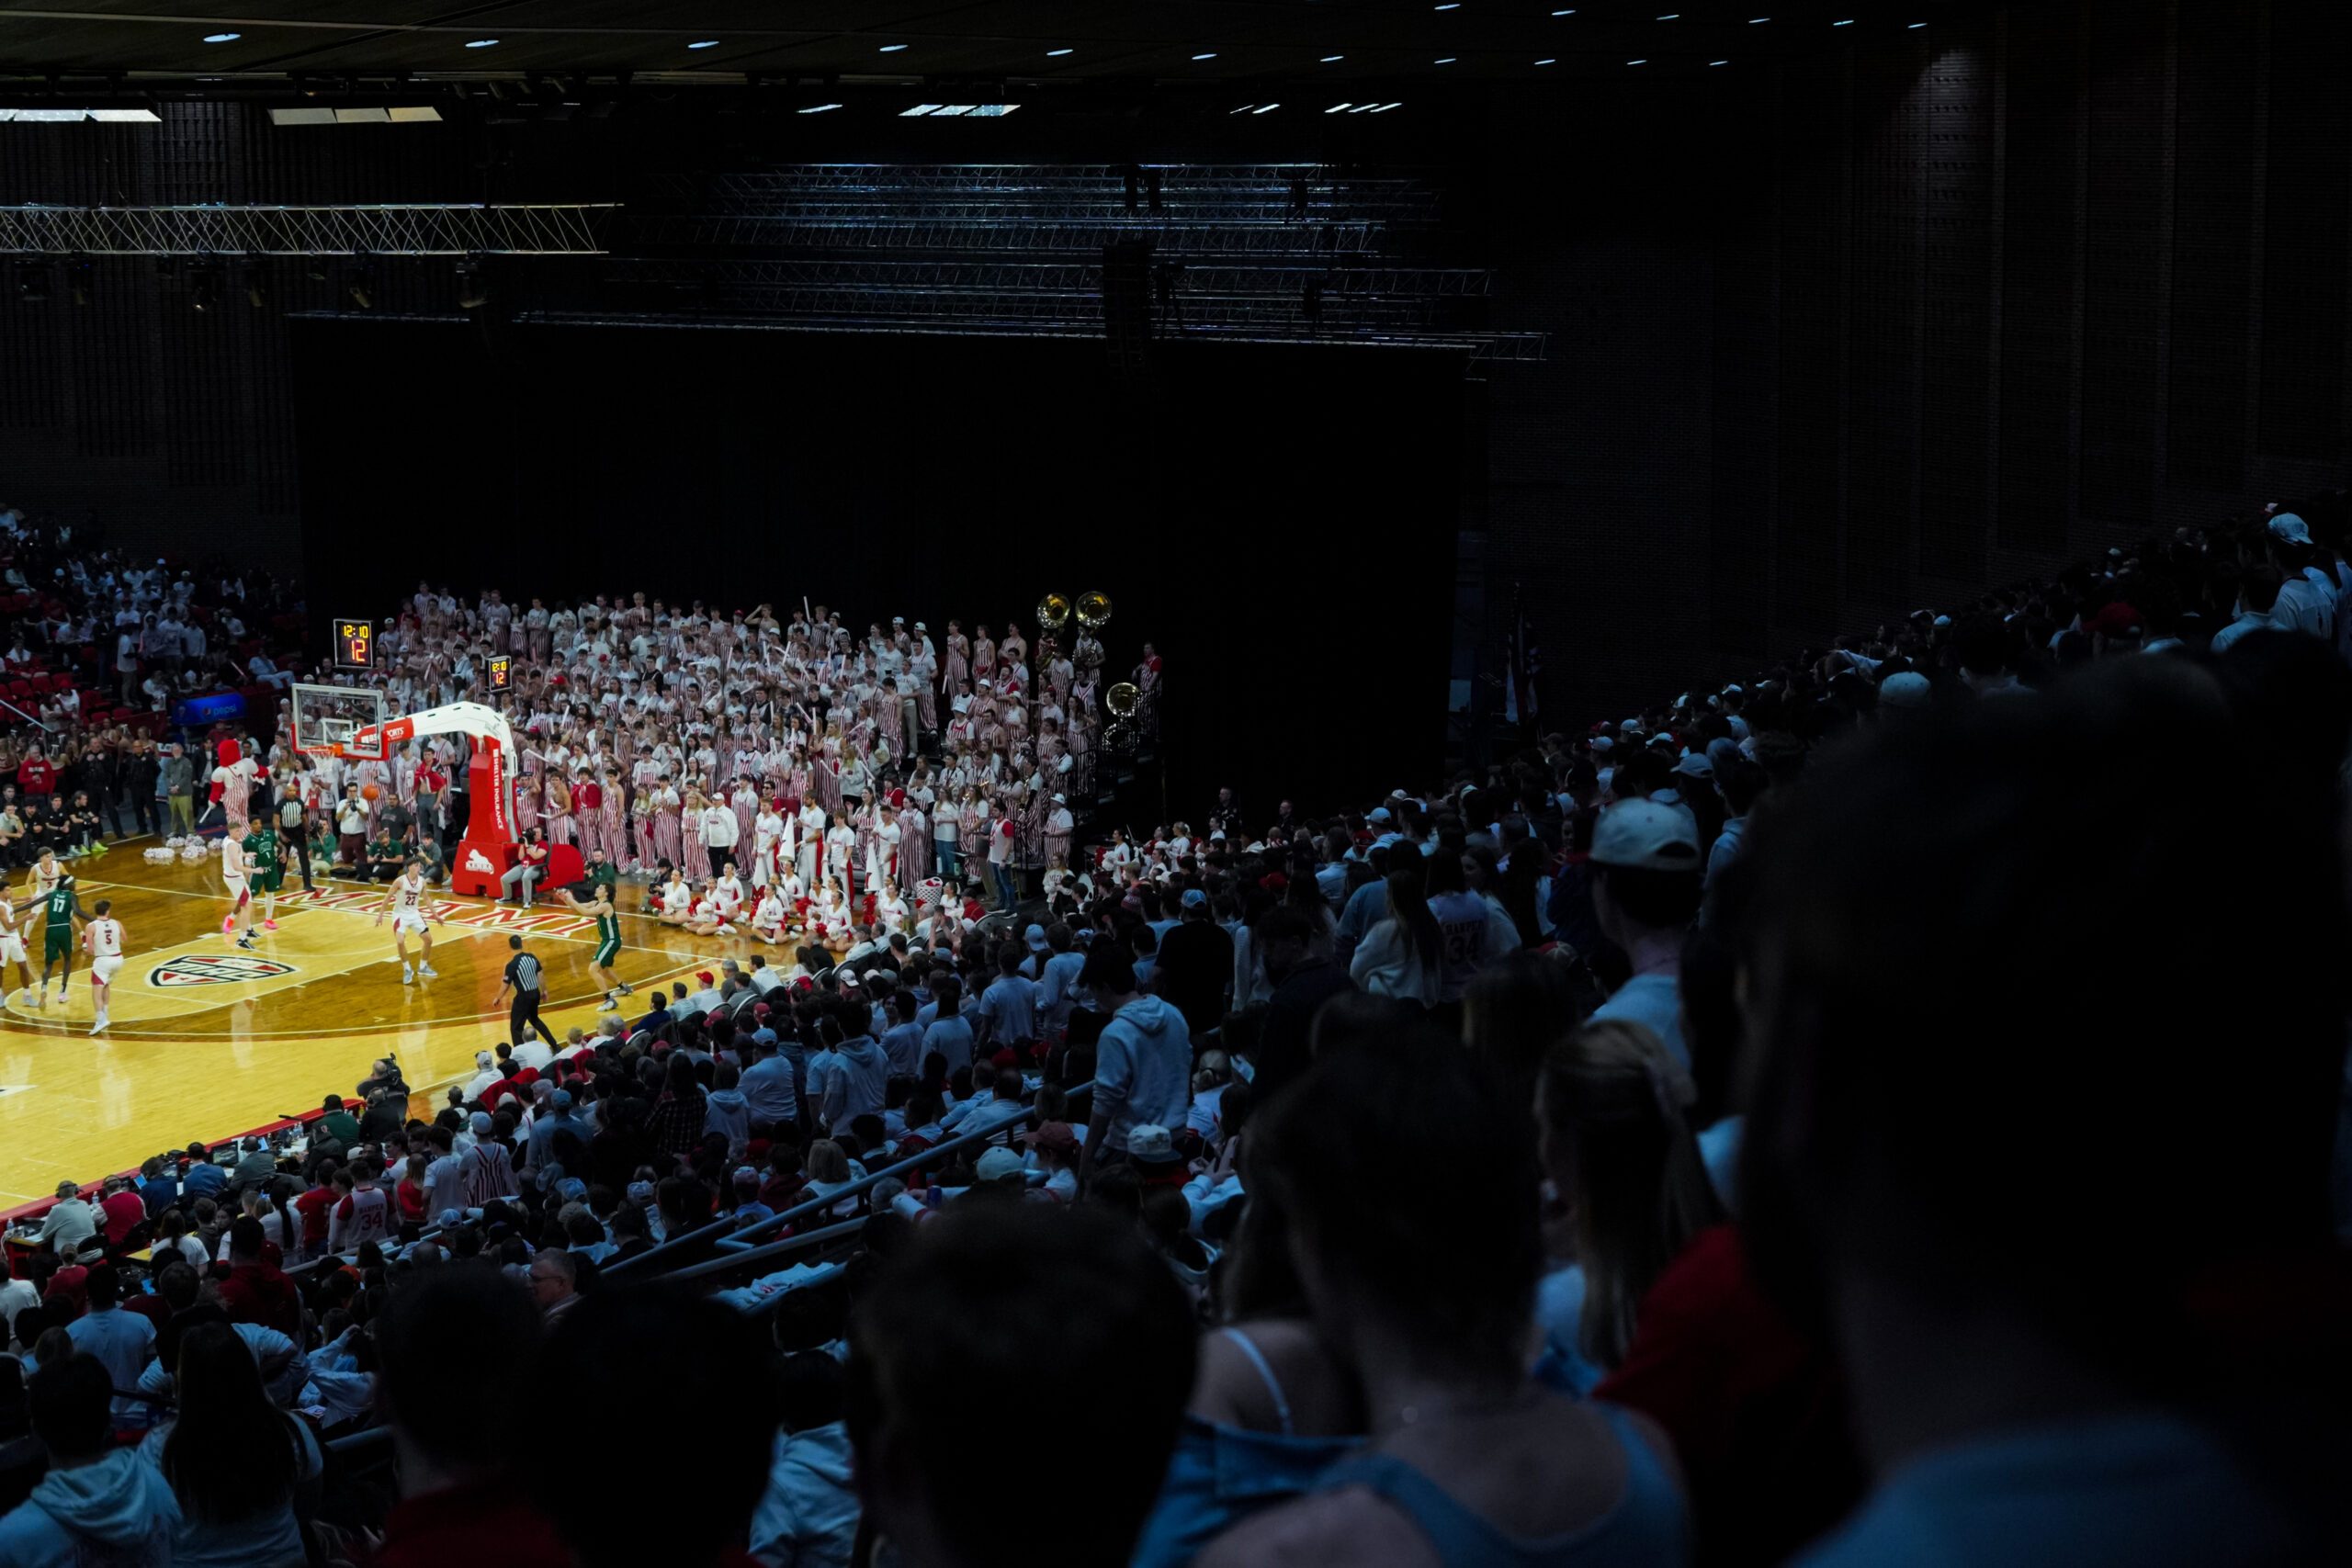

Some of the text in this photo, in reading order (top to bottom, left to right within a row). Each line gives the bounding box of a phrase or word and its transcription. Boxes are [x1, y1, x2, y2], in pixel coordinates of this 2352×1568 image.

[344, 625, 368, 638] 12:10
[351, 639, 366, 661] 12
[496, 672, 504, 684] 12
[213, 704, 238, 716] pepsi
[494, 788, 505, 830] INSURANCE
[52, 897, 66, 913] 17
[405, 896, 416, 906] 22
[106, 933, 112, 945] 5
[1450, 932, 1479, 964] 34
[361, 1211, 383, 1231] 34
